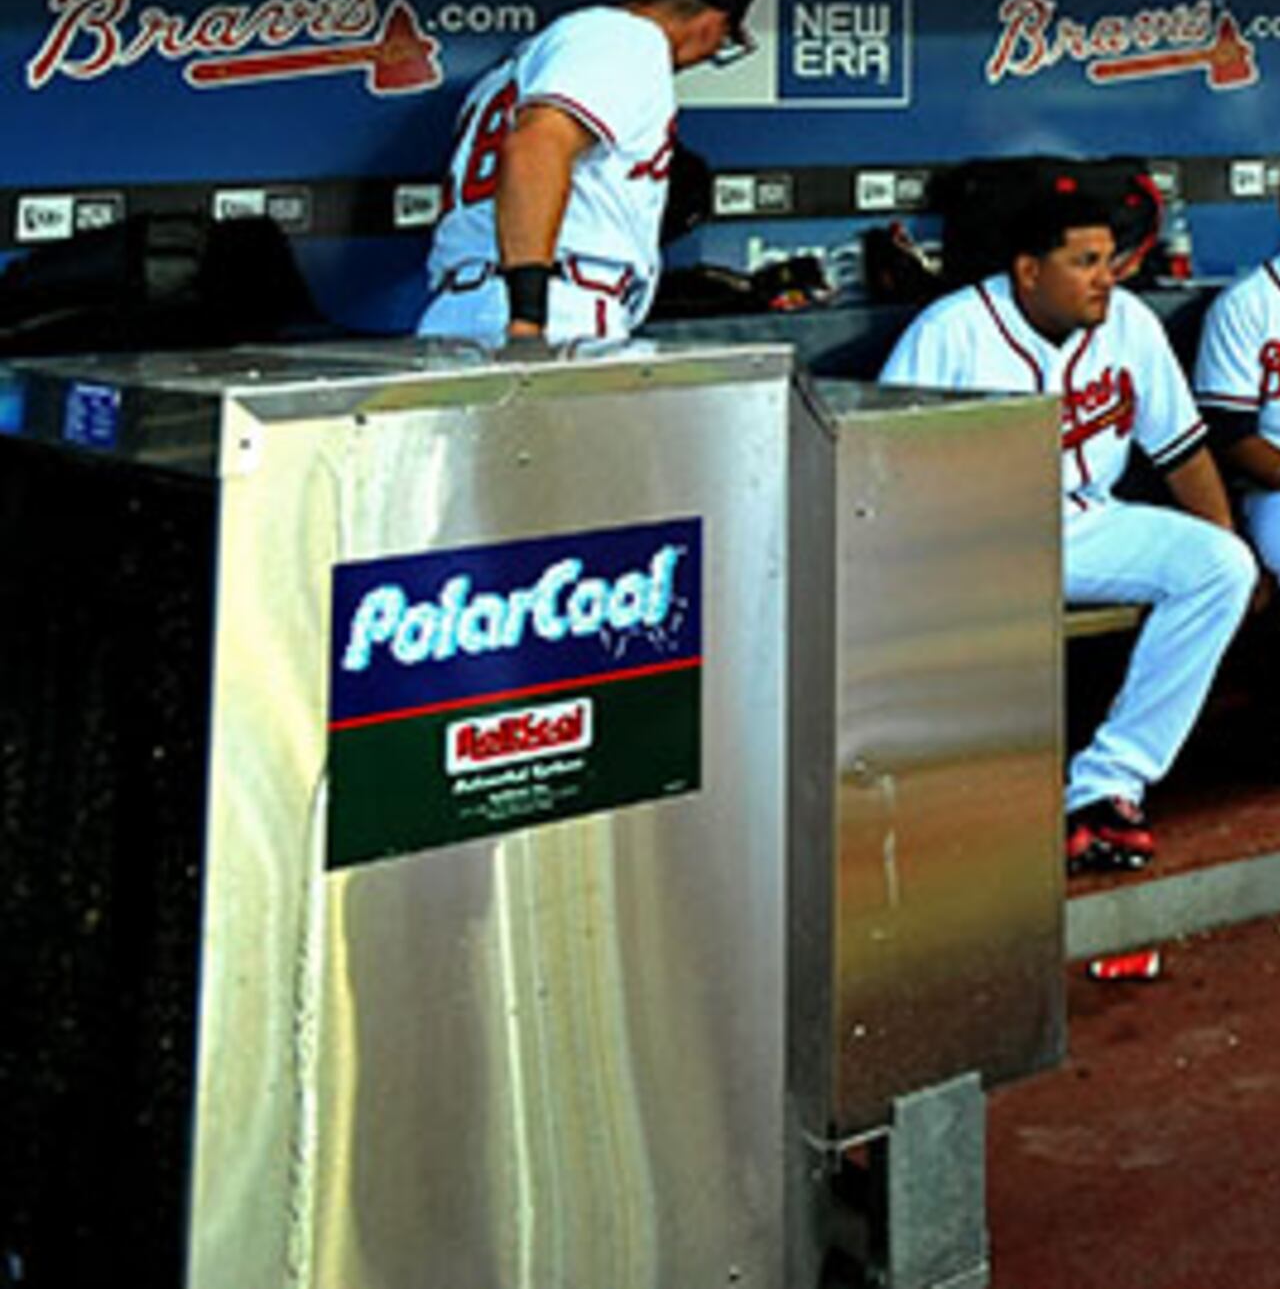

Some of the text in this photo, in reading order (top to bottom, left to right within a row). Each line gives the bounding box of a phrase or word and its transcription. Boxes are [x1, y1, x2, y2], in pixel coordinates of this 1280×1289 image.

[793, 1, 890, 38] NEW
[793, 39, 890, 85] ERA
[342, 545, 679, 671] PolarCool
